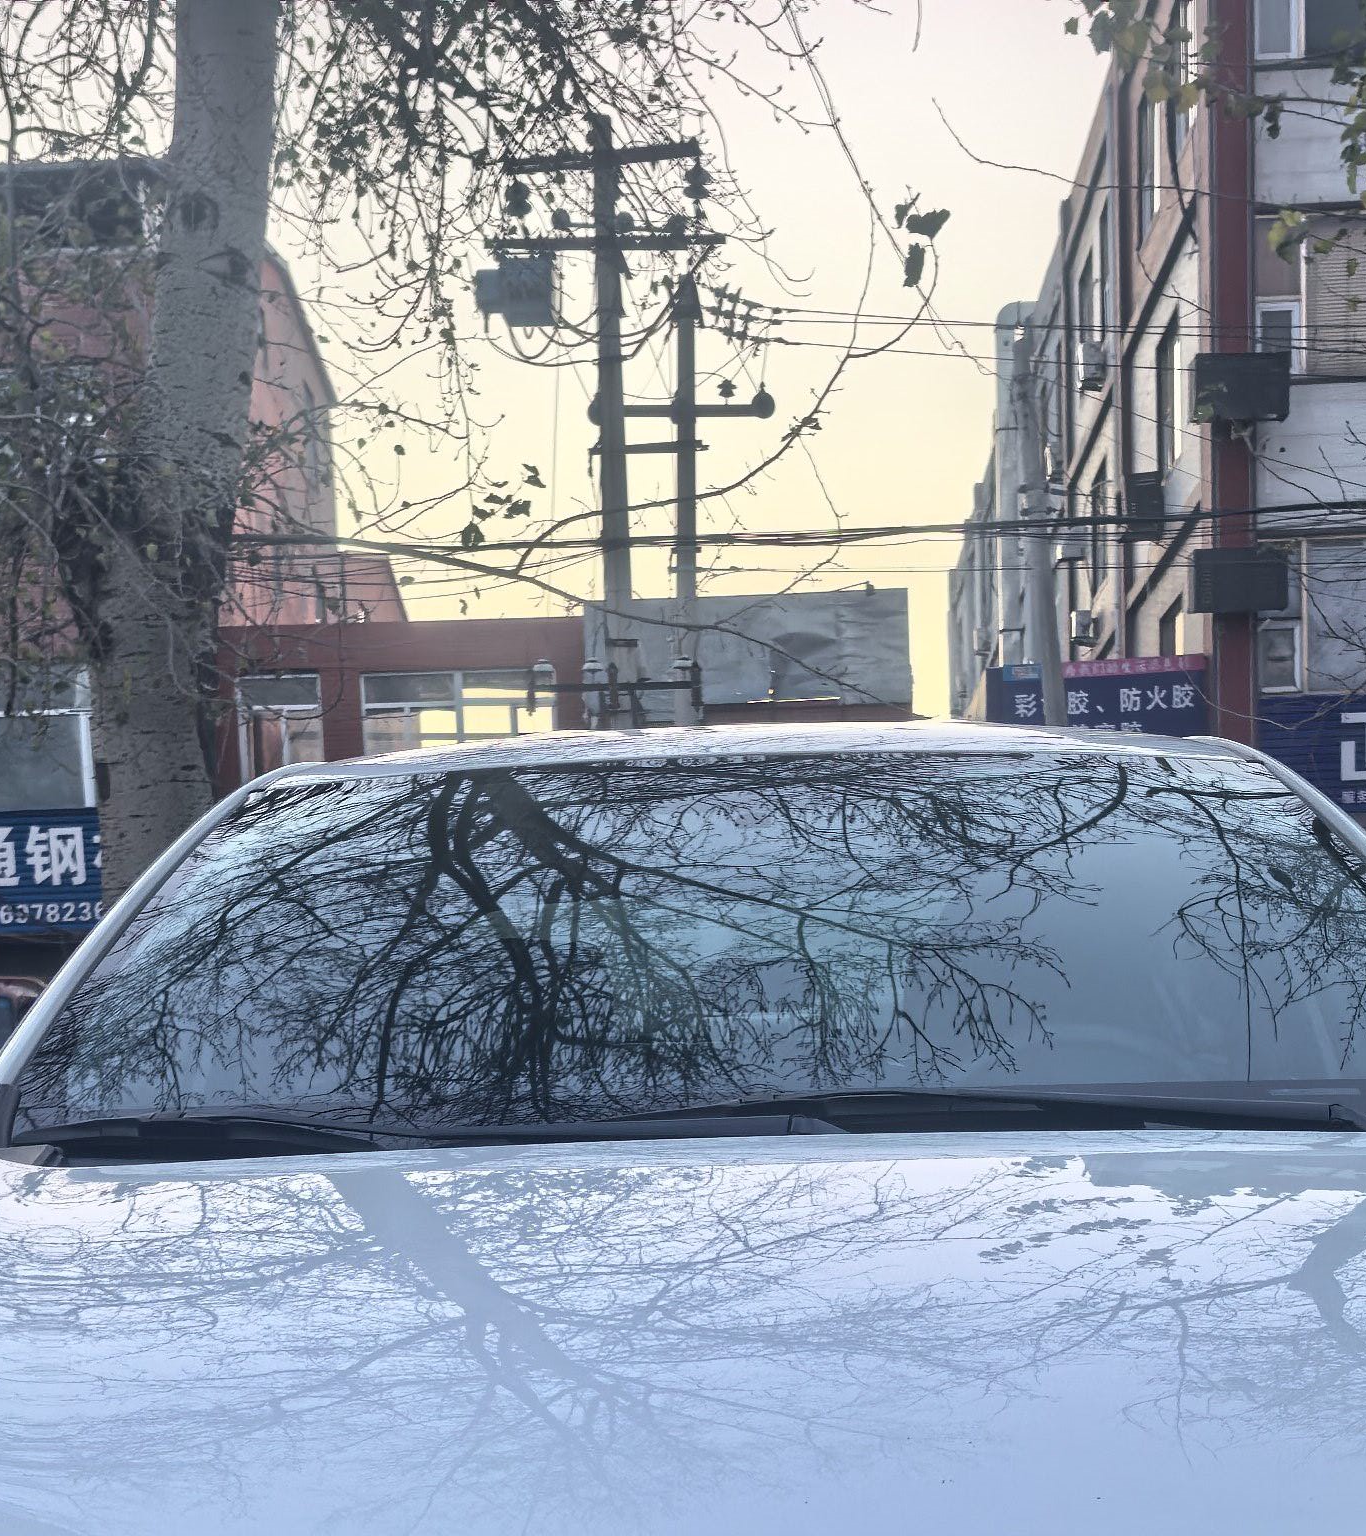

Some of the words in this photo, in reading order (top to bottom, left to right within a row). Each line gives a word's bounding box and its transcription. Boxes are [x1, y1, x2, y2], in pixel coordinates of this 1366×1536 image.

[1014, 683, 1195, 719] 彩胶、防火胶
